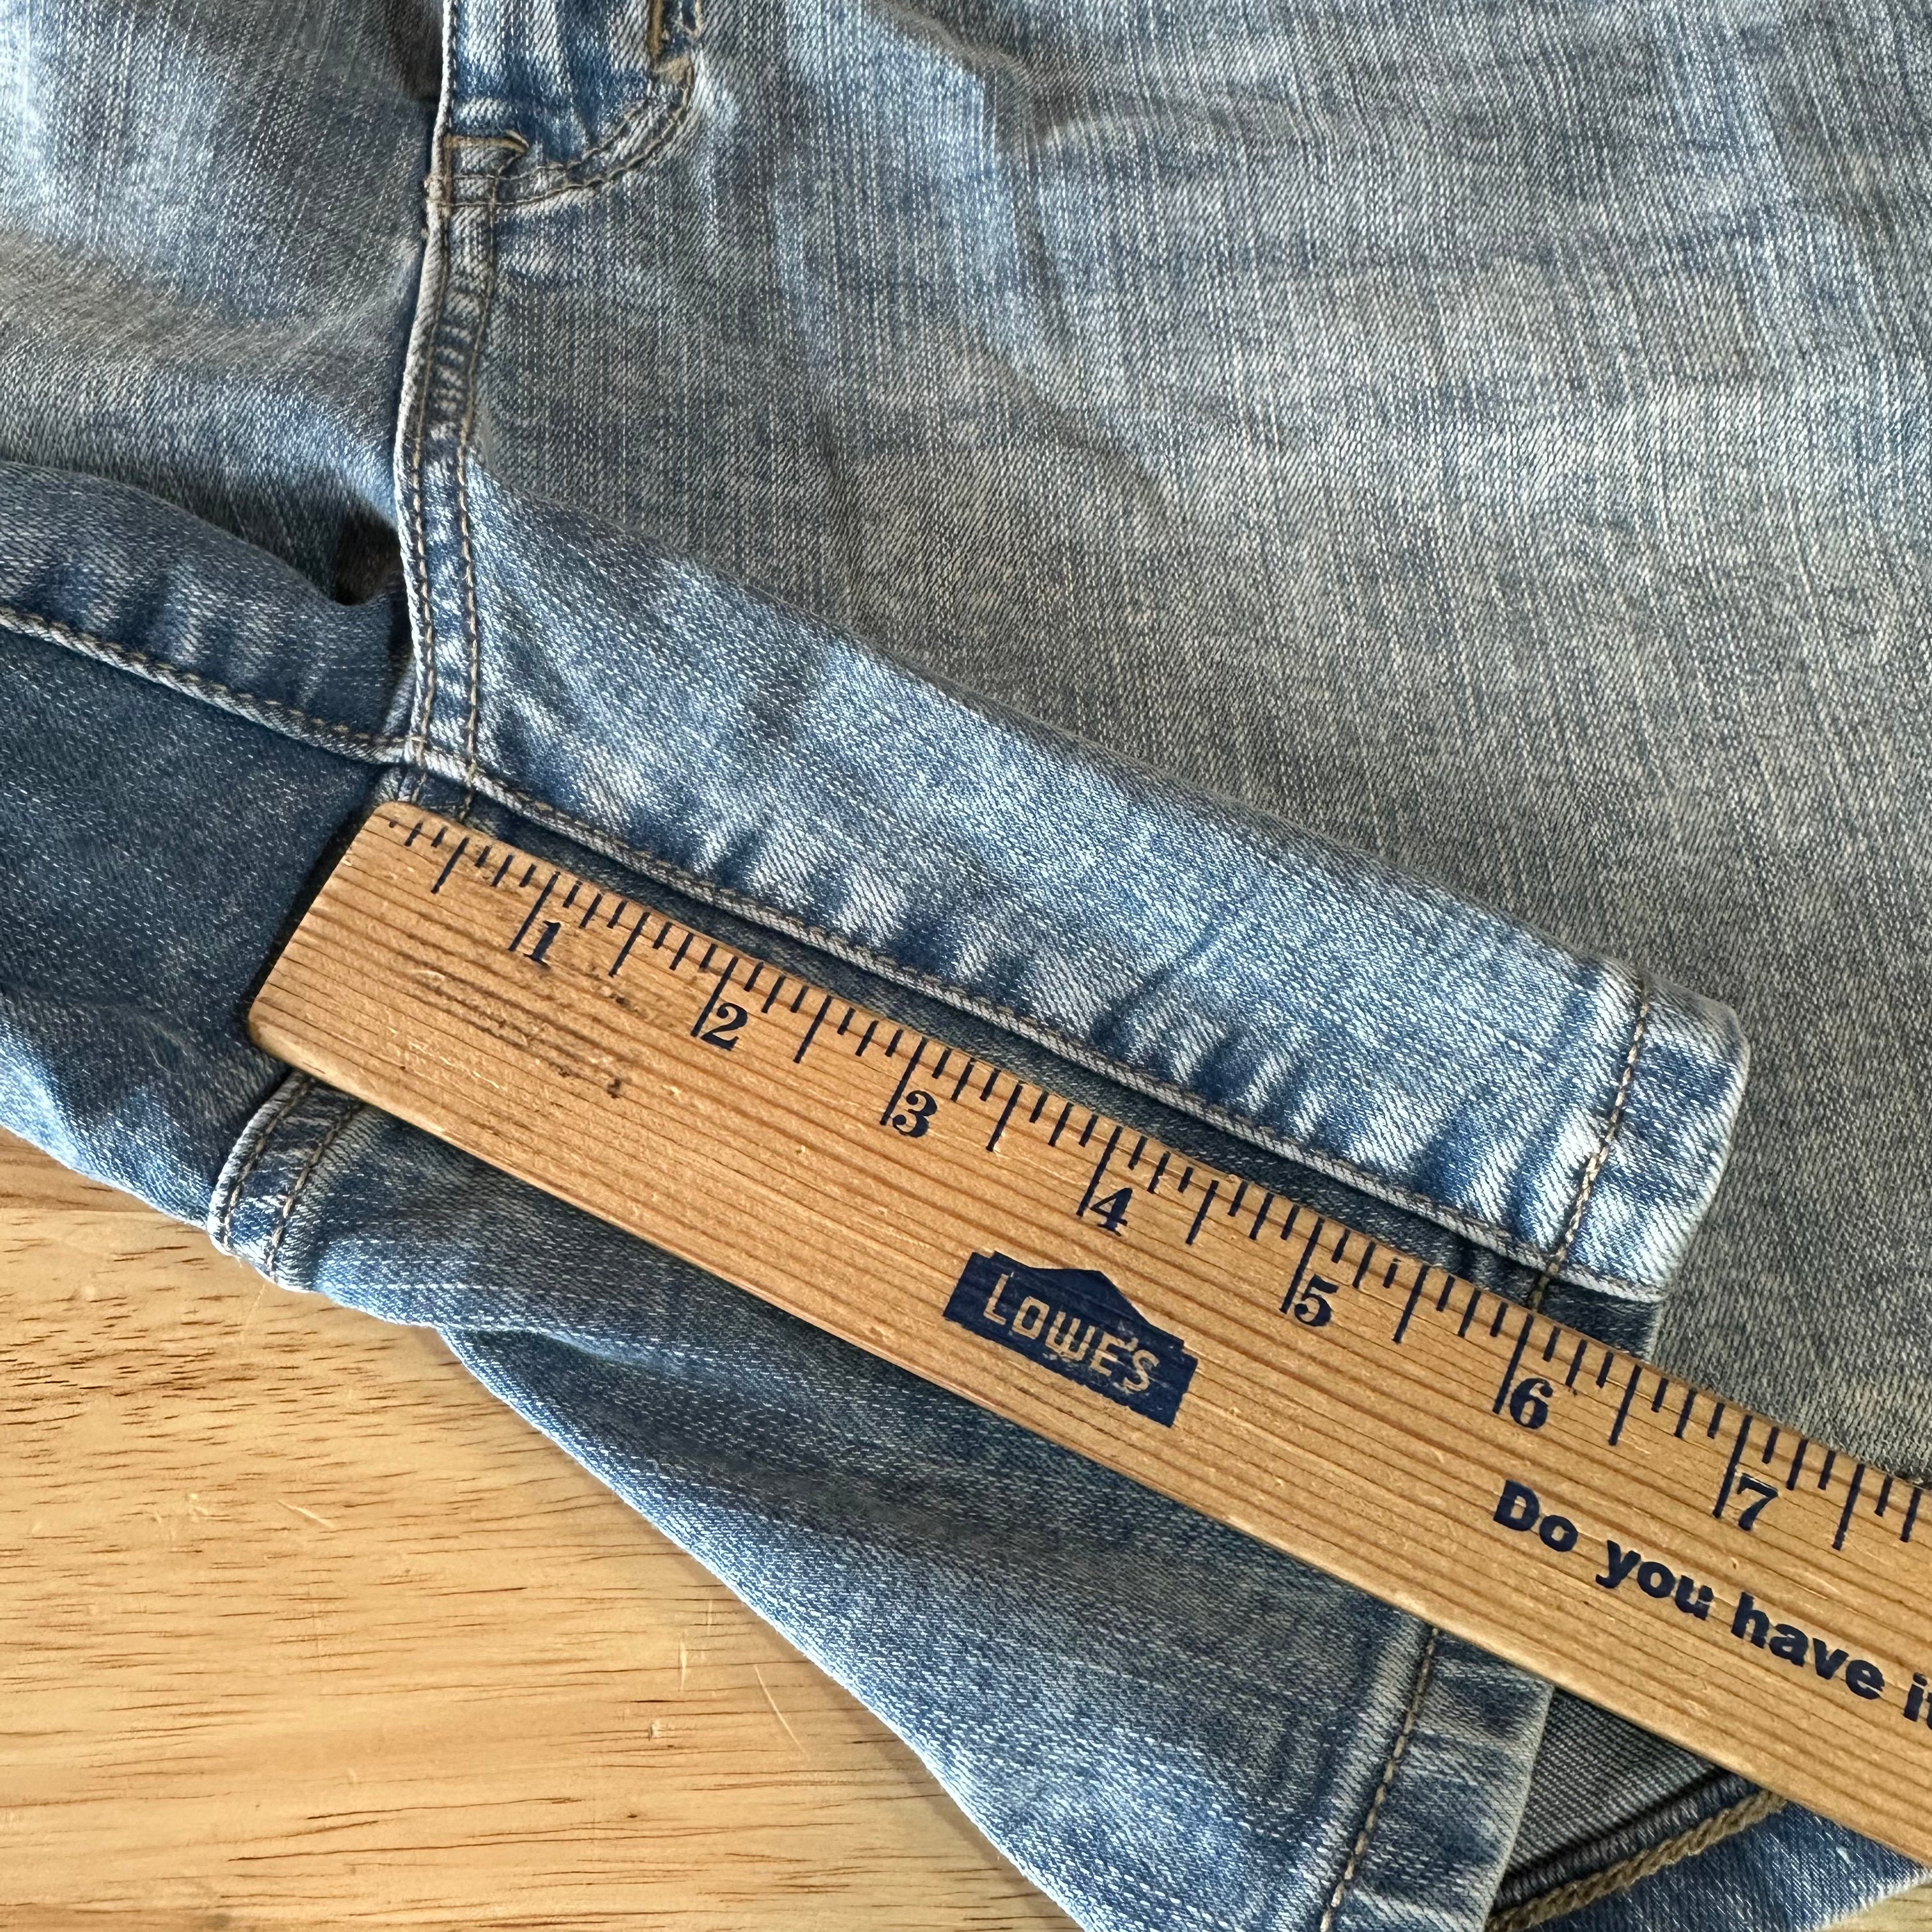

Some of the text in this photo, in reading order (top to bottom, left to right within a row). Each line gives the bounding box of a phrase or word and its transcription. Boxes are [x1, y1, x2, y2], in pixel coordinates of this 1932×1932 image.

[523, 920, 1779, 1531] 1 2 3 4 5 6 7
[983, 1272, 1161, 1393] LOWE'S
[1492, 1479, 1581, 1552] Do
[1595, 1540, 1715, 1621] you
[1731, 1591, 1885, 1701] have
